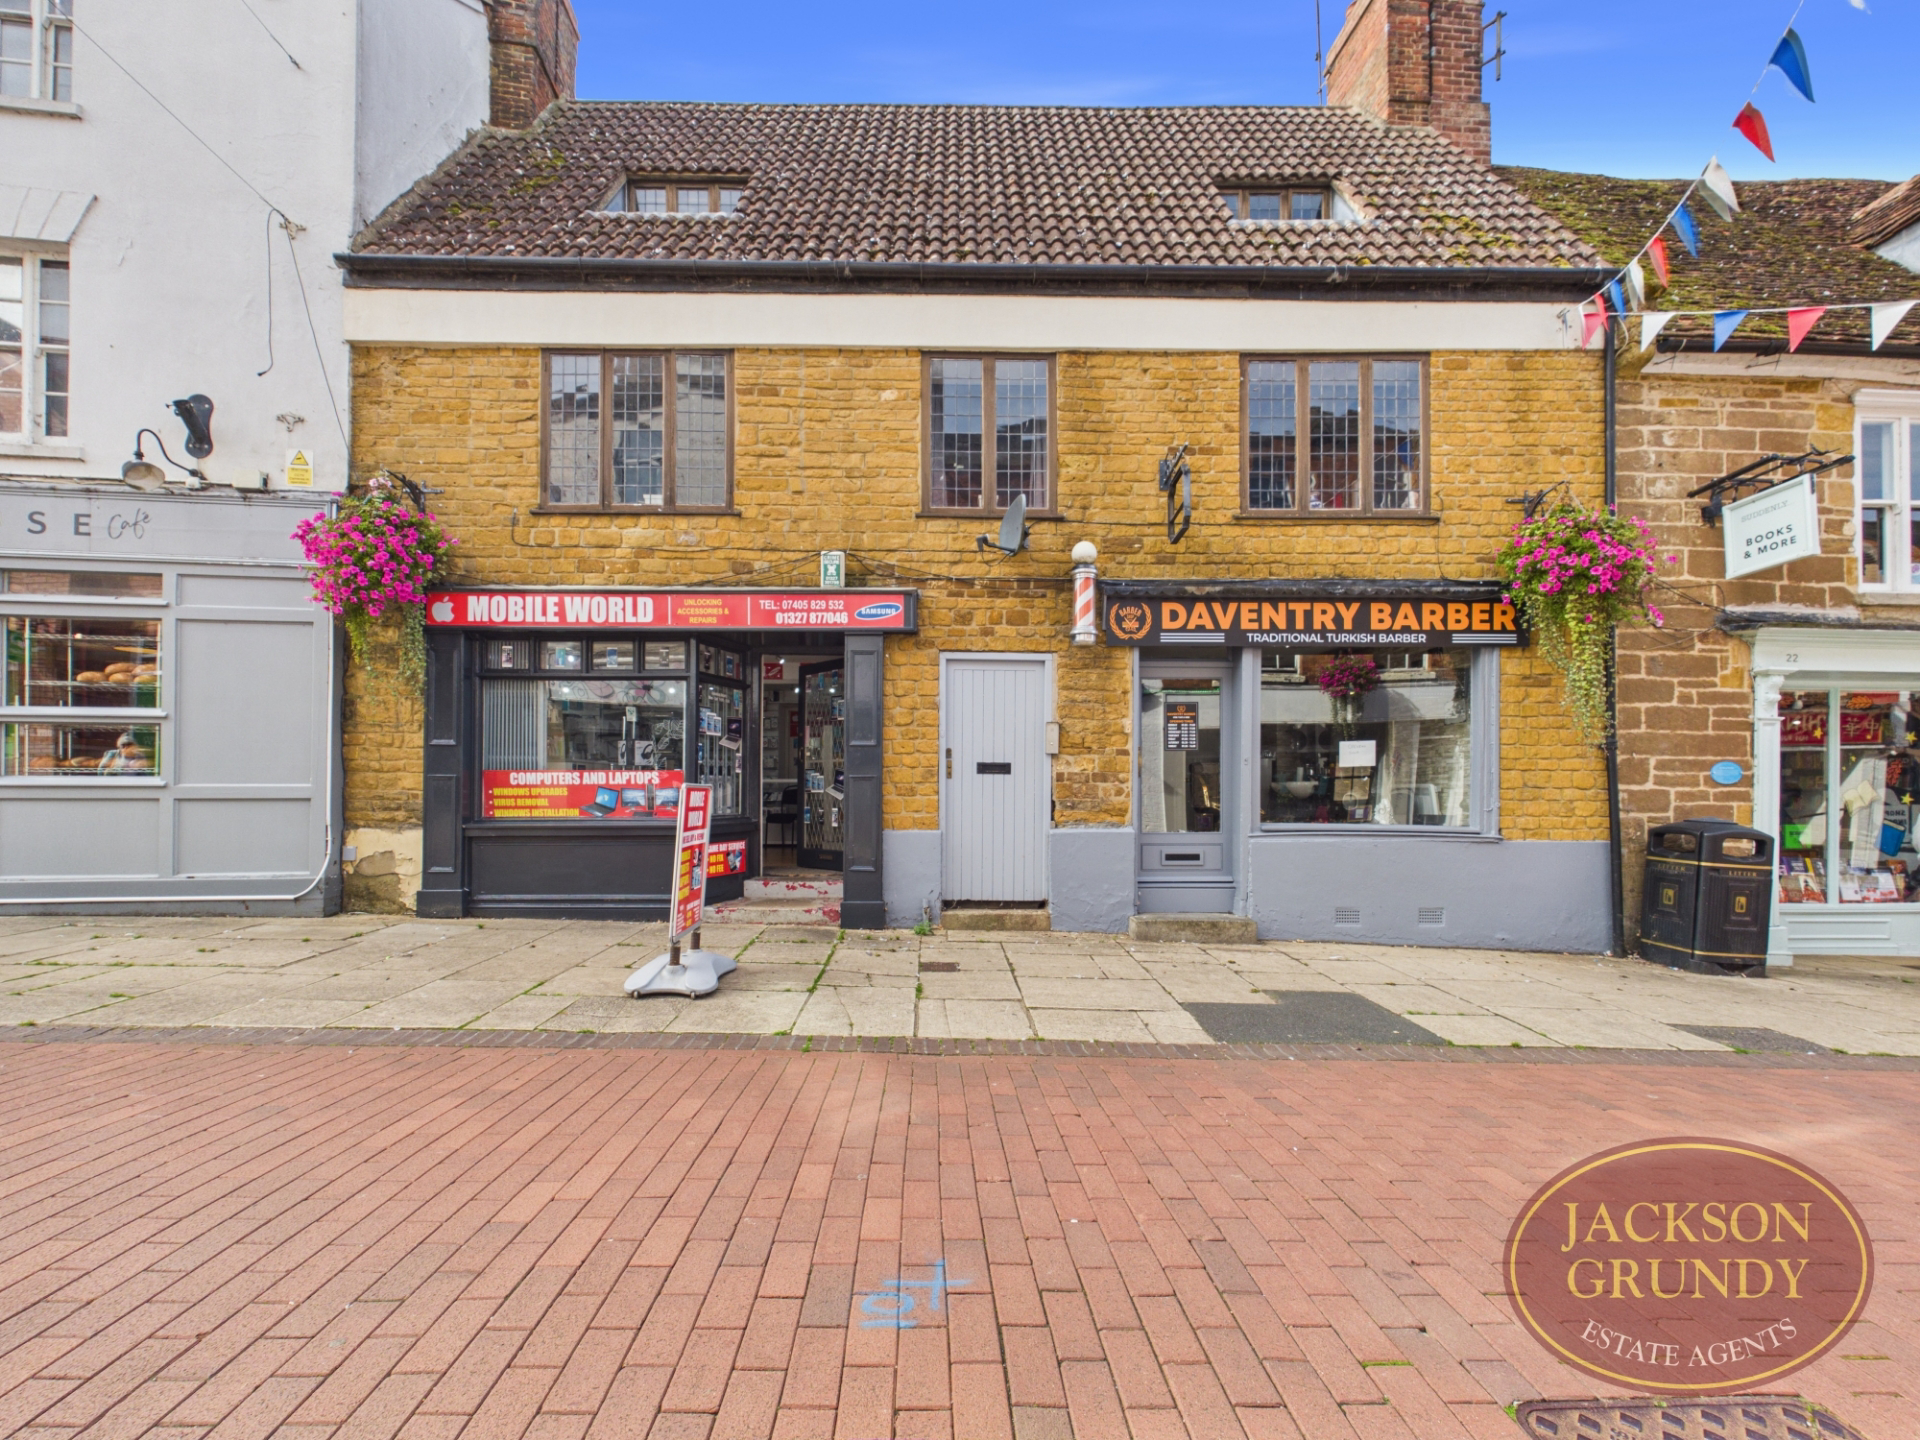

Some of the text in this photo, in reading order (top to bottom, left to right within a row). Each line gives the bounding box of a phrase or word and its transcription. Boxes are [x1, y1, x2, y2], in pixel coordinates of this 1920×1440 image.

[108, 508, 152, 540] Café
[1746, 524, 1793, 547] BOOKS
[1744, 535, 1797, 559] & MORE
[683, 598, 722, 606] UNLOCKING
[759, 600, 844, 610] TEL: 07405 829 532
[467, 595, 654, 623] MOBILE WORLD
[677, 607, 730, 615] ACCESSORIES &
[861, 607, 896, 615] SAMSUNG
[1118, 606, 1142, 617] BARBER
[689, 616, 717, 624] REPAIRS
[776, 612, 848, 624] 01327 877046
[1161, 601, 1516, 631] DAVENTRY BARBER
[1246, 632, 1426, 643] TRADITIONAL TURKISH BARBER
[1786, 653, 1799, 663] 22
[509, 771, 659, 785] COMPUTERS AND LAPTOPS
[493, 788, 568, 796] WINDOWS UPGRADES
[494, 798, 549, 806] VIRUS REMOVAL
[494, 808, 580, 817] WINDOWS INSTALLATION
[1658, 863, 1686, 872] LITTER
